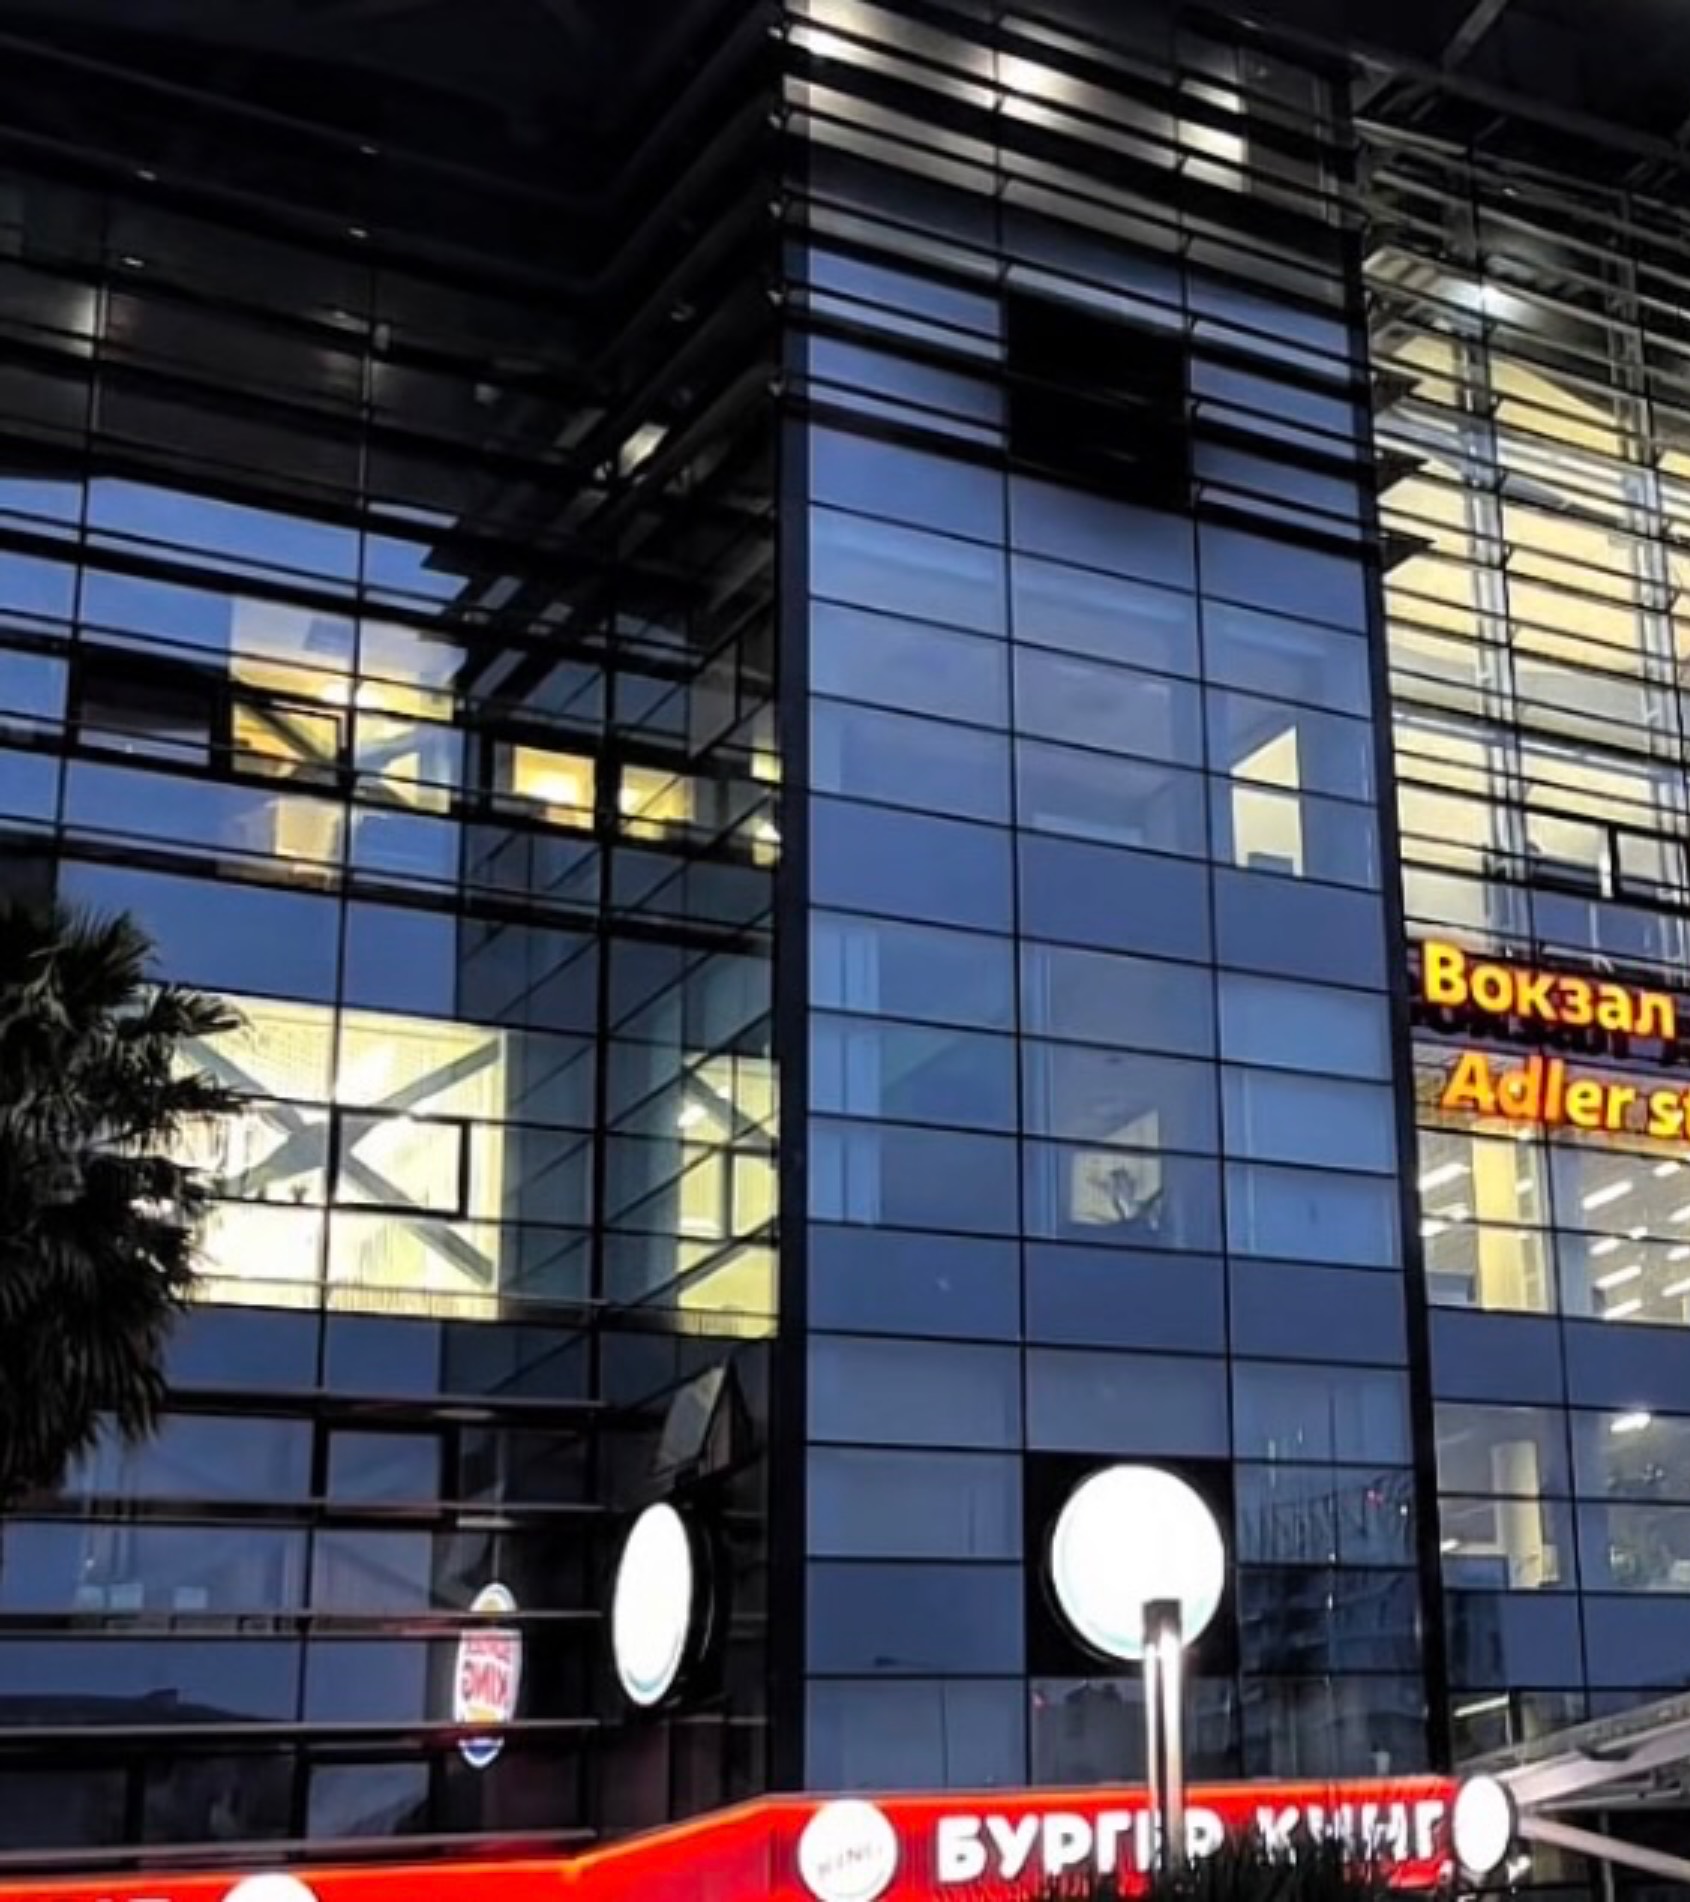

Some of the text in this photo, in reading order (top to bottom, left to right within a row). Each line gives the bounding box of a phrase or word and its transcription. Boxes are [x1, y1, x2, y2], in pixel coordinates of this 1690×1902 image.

[1423, 940, 1676, 1038] Вокзал
[1440, 1050, 1636, 1130] Adler
[937, 1805, 1225, 1882] БУРГЕР
